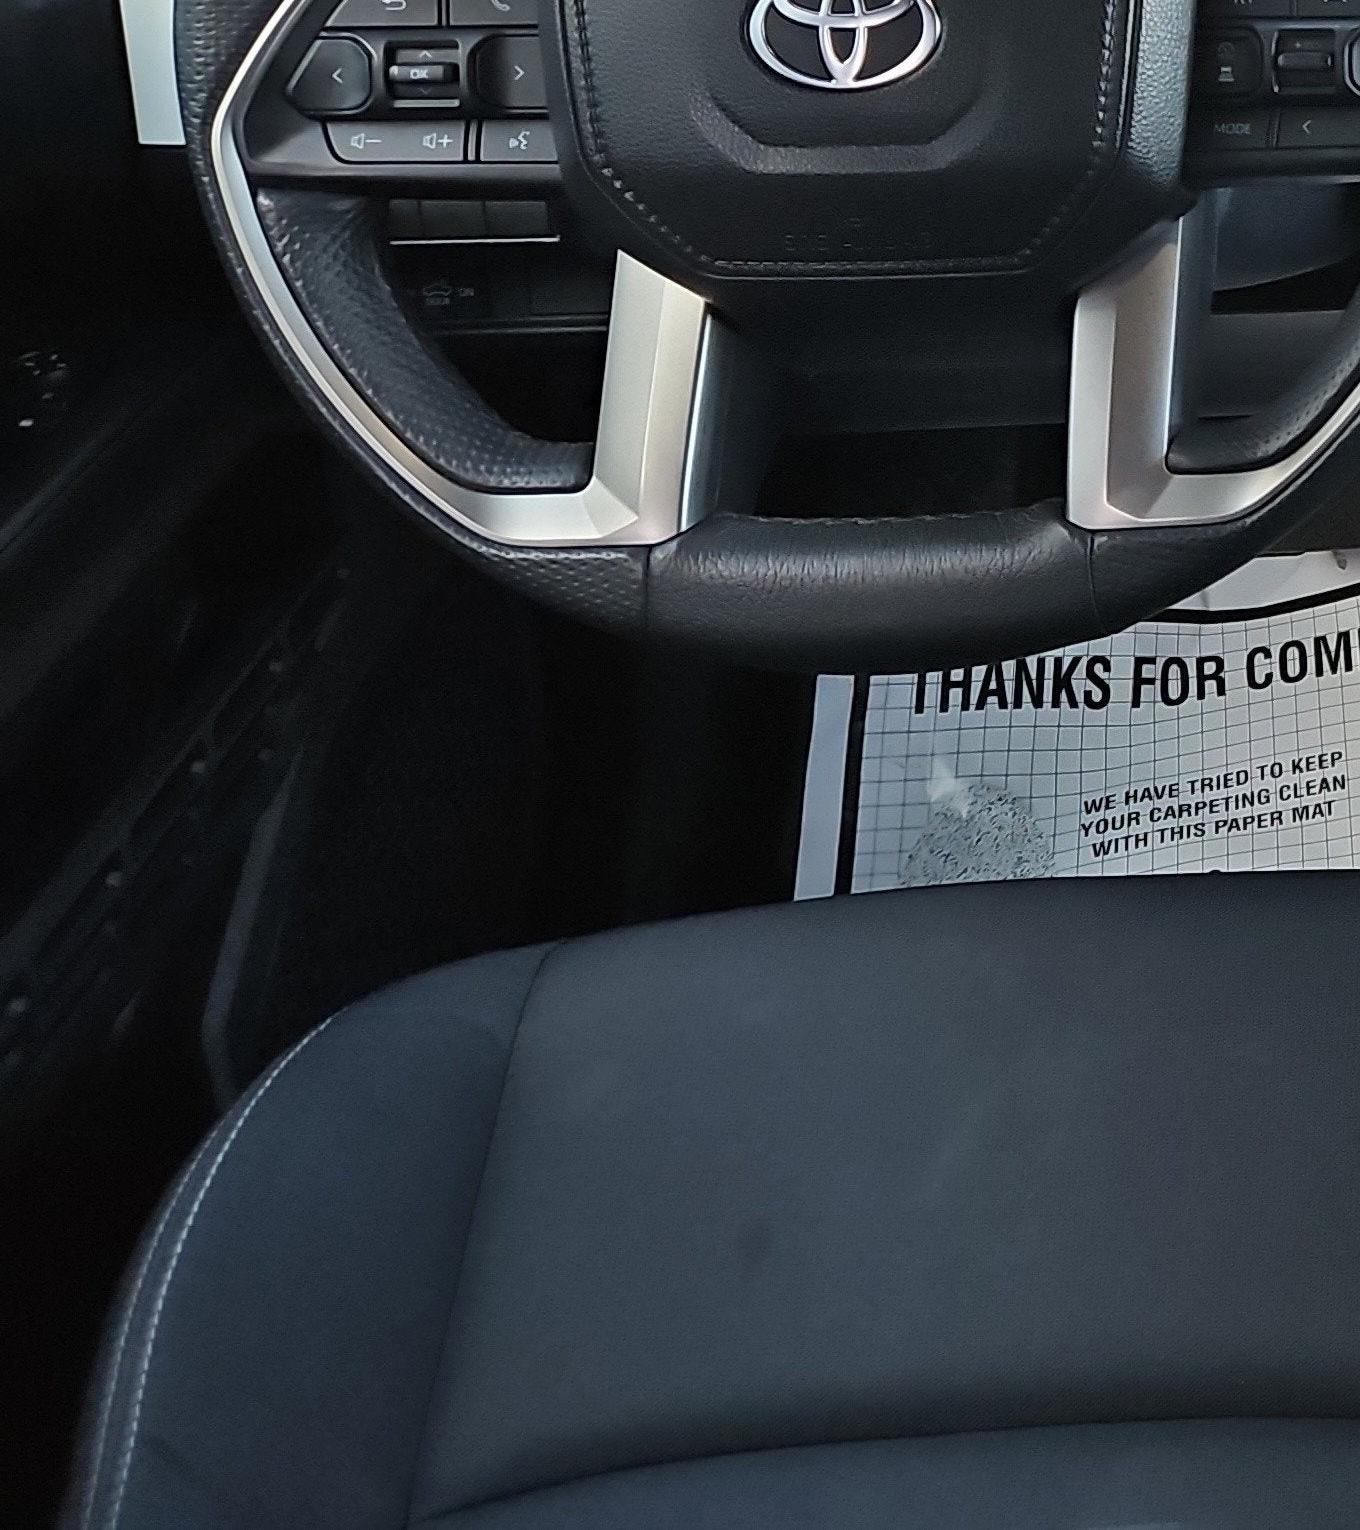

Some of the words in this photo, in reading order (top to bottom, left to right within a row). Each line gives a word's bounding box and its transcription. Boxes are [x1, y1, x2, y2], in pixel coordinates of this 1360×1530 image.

[409, 69, 429, 80] OK
[1213, 122, 1251, 135] MODE
[912, 654, 1112, 715] THANKS
[1131, 653, 1227, 709] FOR
[1080, 810, 1141, 838] YOUR
[1149, 787, 1271, 824] CARPETING
[1279, 773, 1347, 803] CLEAN
[1083, 793, 1117, 815] WE
[1124, 782, 1180, 807] HAVE
[1186, 769, 1249, 796] TRIED
[1257, 761, 1283, 782] TO
[1291, 750, 1343, 776] KEEP
[1091, 831, 1149, 858] WITH
[1154, 822, 1206, 844] THIS
[1214, 810, 1283, 835] PAPER
[1292, 799, 1336, 823] MAT
